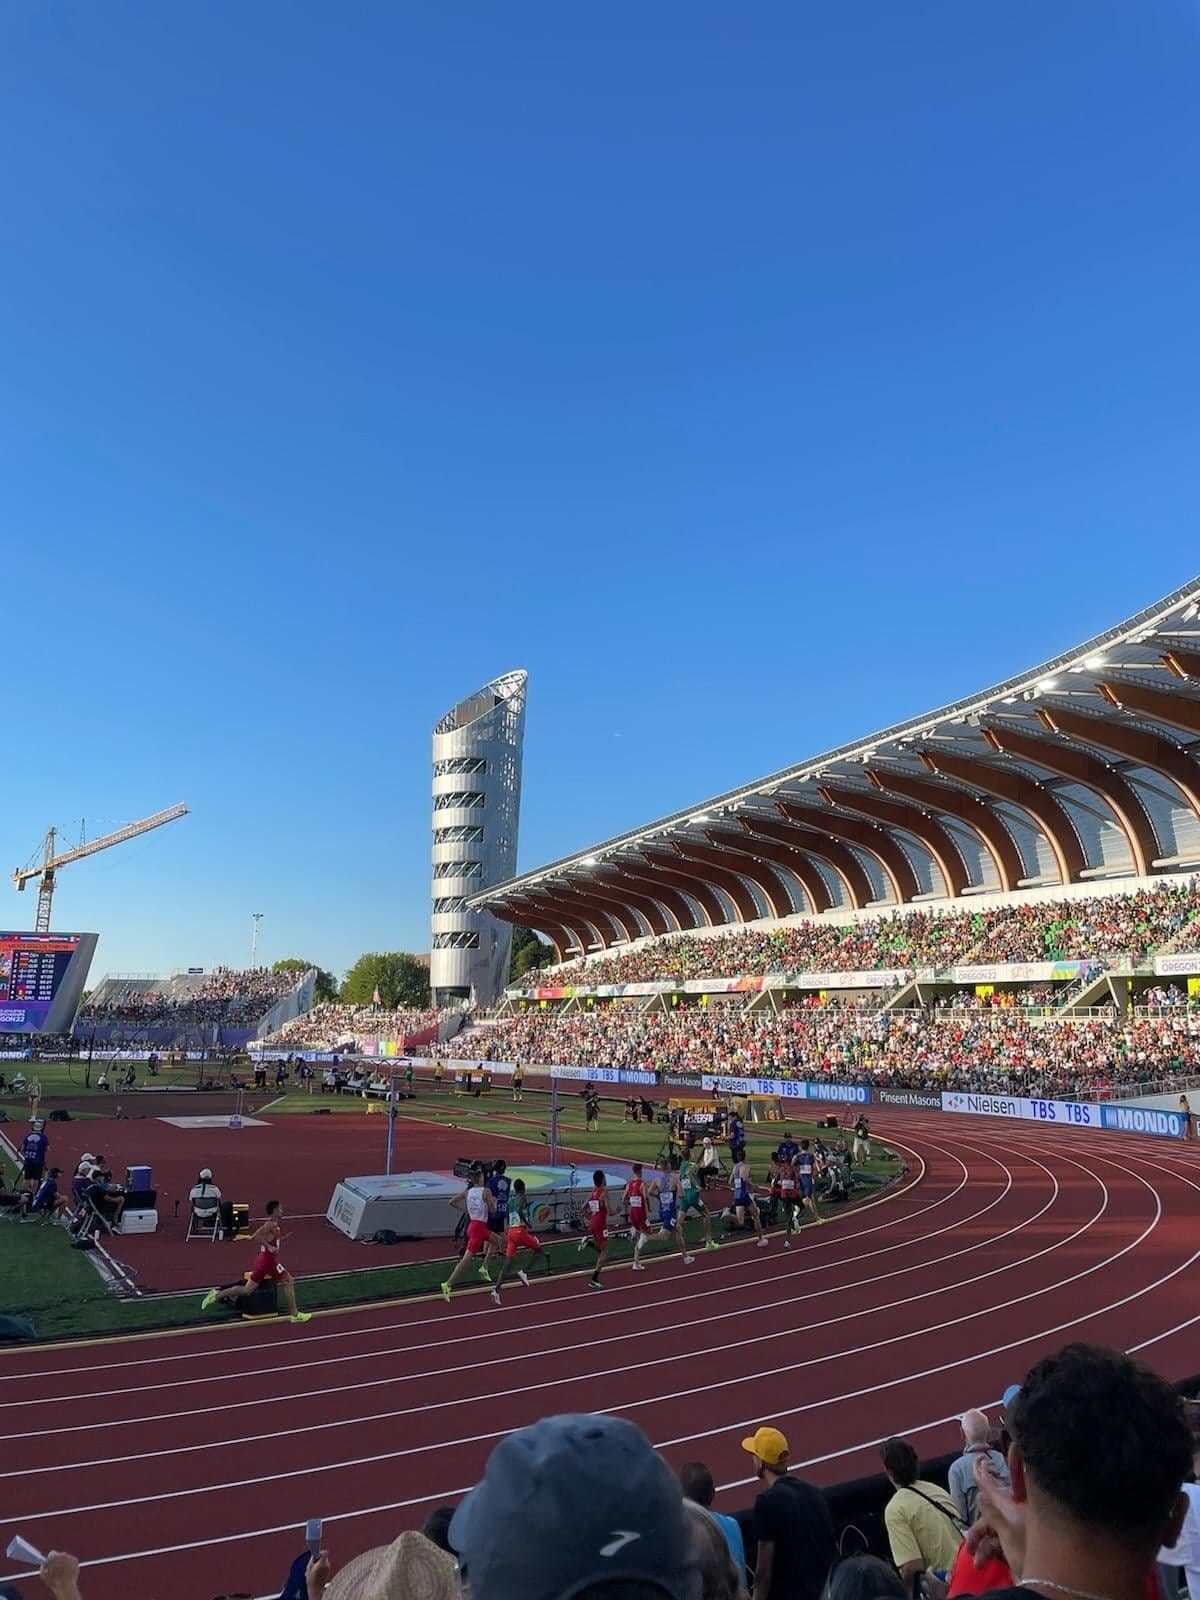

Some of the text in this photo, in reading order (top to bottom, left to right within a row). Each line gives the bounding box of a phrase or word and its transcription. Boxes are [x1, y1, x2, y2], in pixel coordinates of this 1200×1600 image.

[1162, 961, 1200, 971] OREGON
[587, 1068, 614, 1081] TBS TBS
[626, 1071, 657, 1084] MONDO
[757, 1080, 799, 1097] TBS TBS
[819, 1086, 865, 1102] MONDO
[880, 1091, 941, 1107] Pinsent Masons
[967, 1096, 1016, 1115] Nielsen
[1030, 1100, 1091, 1124] TBS TBS
[1117, 1109, 1180, 1136] MONDO
